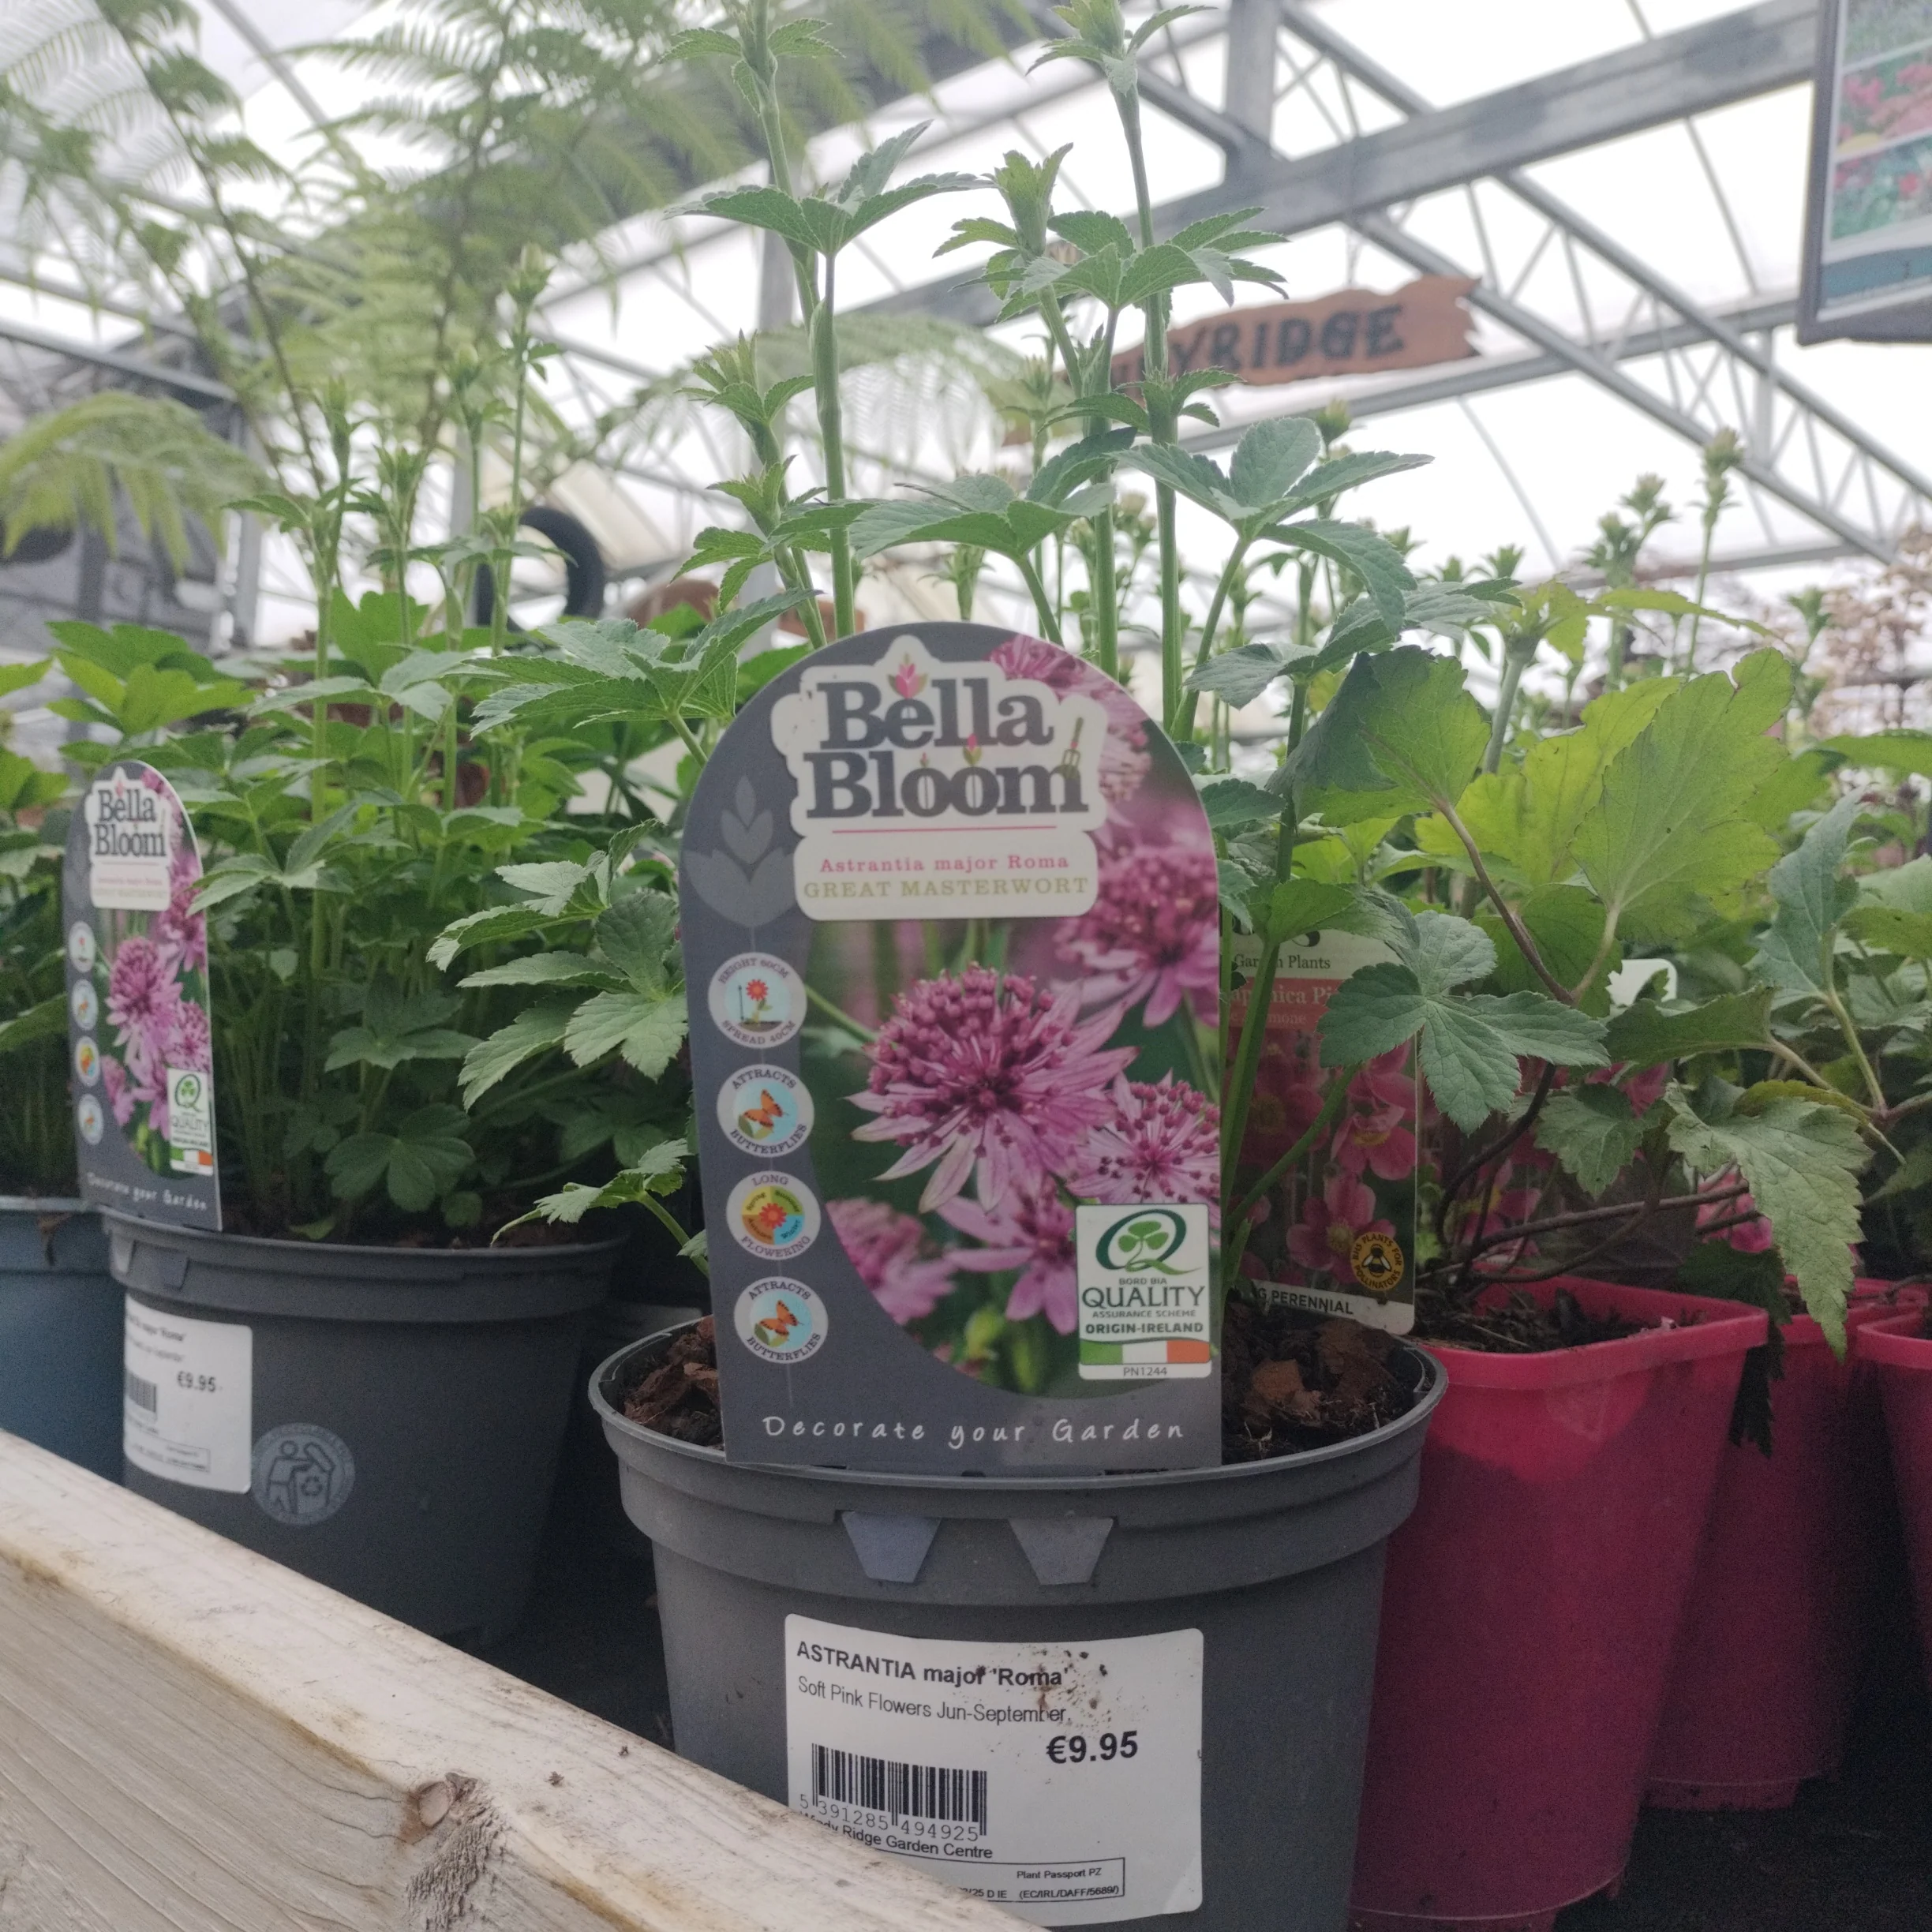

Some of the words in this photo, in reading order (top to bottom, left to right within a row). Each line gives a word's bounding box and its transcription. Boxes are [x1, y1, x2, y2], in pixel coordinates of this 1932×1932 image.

[1129, 304, 1405, 382] YRIDGE
[816, 678, 1054, 749] Bella
[803, 751, 1089, 818] Bloom
[98, 789, 157, 822] Bella
[94, 824, 167, 856] Bloom
[820, 858, 925, 872] Astrantia
[934, 856, 998, 873] major
[1008, 856, 1069, 869] Roma
[803, 882, 891, 898] GREAT
[901, 877, 1089, 897] MASTERWORT
[718, 957, 758, 984] HEIGHT
[1234, 953, 1283, 968] Garn
[1288, 954, 1331, 969] Plants
[721, 1019, 766, 1045] SPREAD
[732, 1069, 797, 1090] ATTRACTS
[729, 1123, 807, 1155] BUTTERFLIES
[752, 1174, 789, 1185] LONG
[740, 1235, 811, 1258] FLOWERING
[1361, 1234, 1394, 1248] PLANTS
[1354, 1264, 1401, 1289] POLLINATORS
[748, 1280, 811, 1301] ATTRACTS
[1081, 1286, 1206, 1309] QUALITY
[1272, 1290, 1354, 1315] PERENNIAL
[1085, 1323, 1204, 1335] ORIGIN-IRELAND
[747, 1332, 822, 1361] BUTTERFLIES
[178, 1370, 217, 1393] €9.95
[1123, 1367, 1168, 1376] PN1244
[762, 1416, 926, 1438] Decorate
[948, 1423, 1027, 1449] your
[1051, 1417, 1184, 1443] Garden
[796, 1641, 916, 1680] ASTRANTIA
[923, 1665, 986, 1687] major
[799, 1676, 826, 1699] Soft
[831, 1683, 863, 1708] Pink
[869, 1691, 932, 1718] Flowers
[1046, 1729, 1138, 1765] €9.95
[818, 1799, 889, 1831] 391285
[900, 1820, 979, 1842] 494925
[842, 1824, 882, 1847] Ridge
[886, 1835, 938, 1855] Garden
[943, 1843, 994, 1859] Centre
[1017, 1870, 1041, 1879] Plant
[1044, 1870, 1086, 1880] Passport
[1088, 1867, 1103, 1876] PZ
[987, 1889, 995, 1899] D
[997, 1889, 1008, 1899] IE
